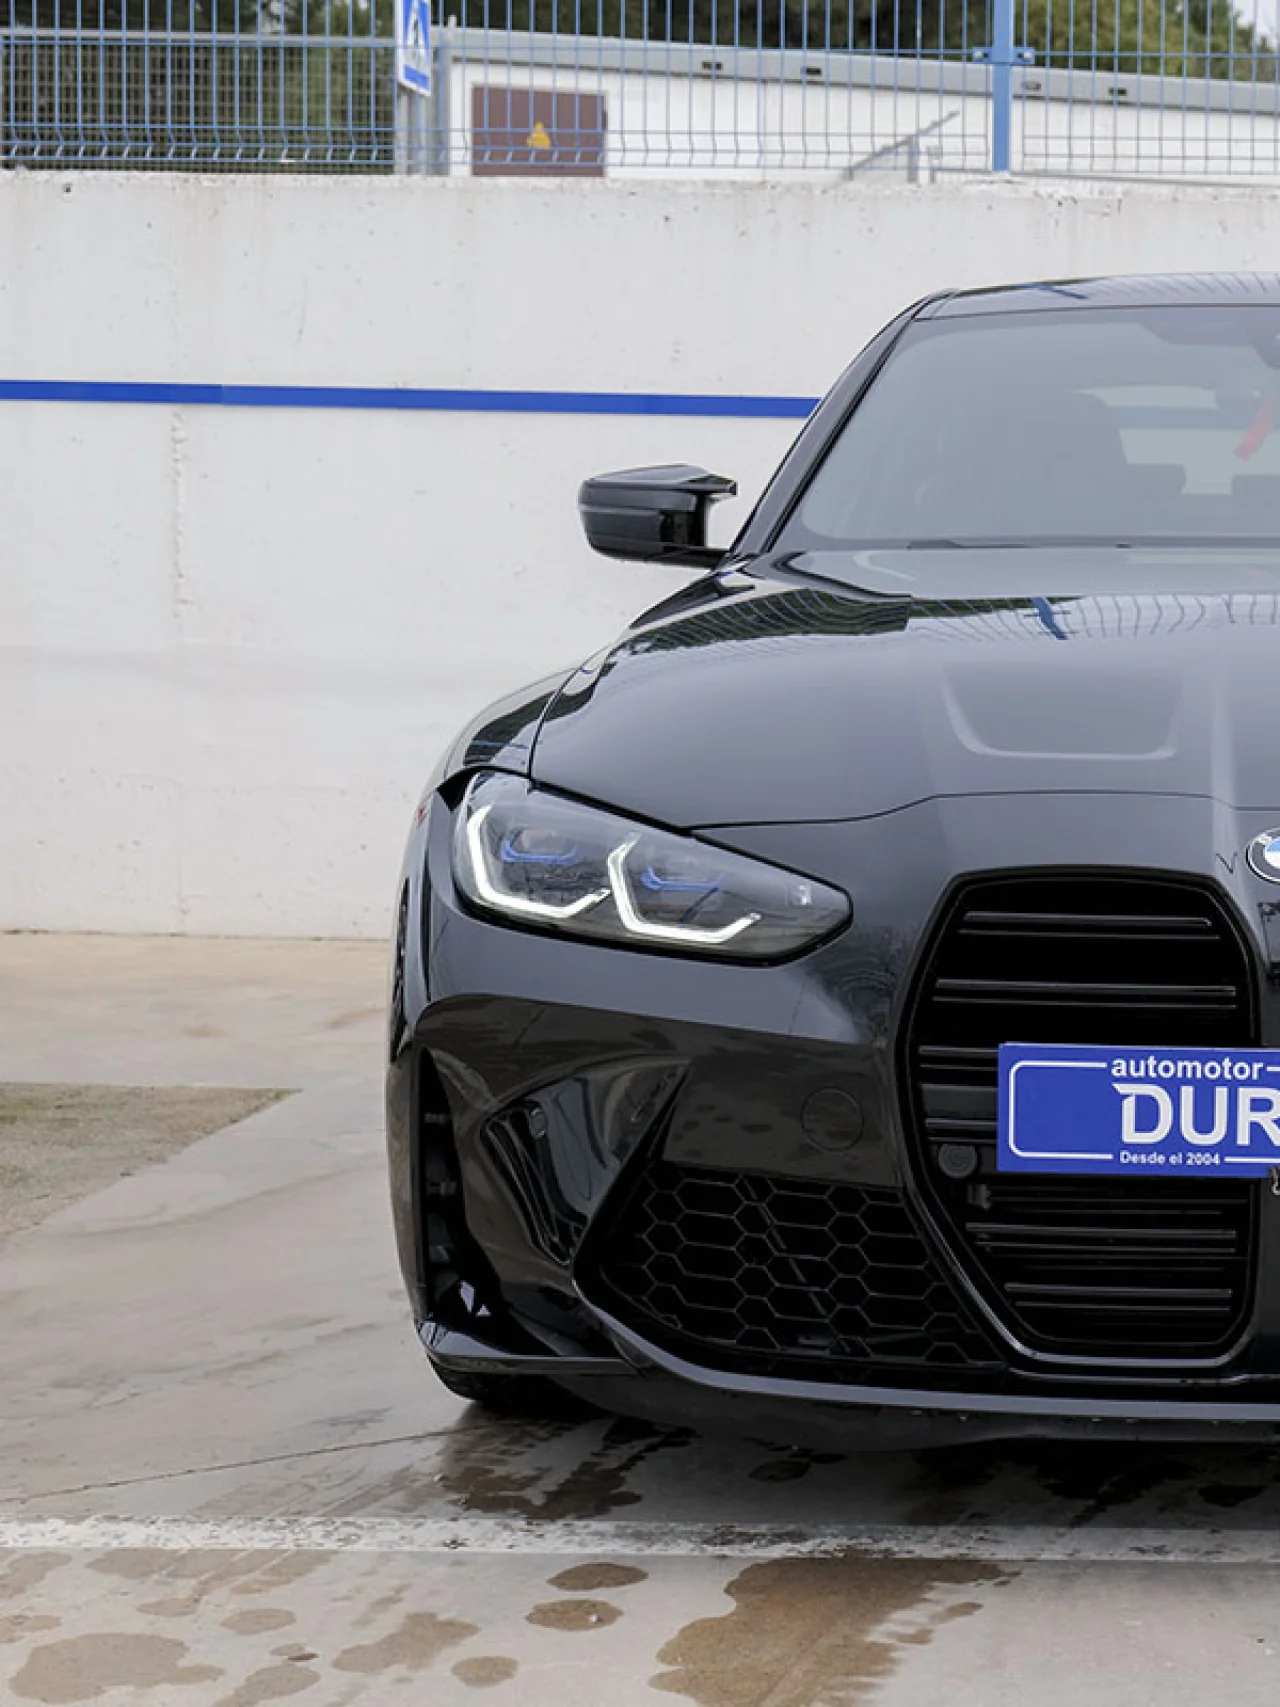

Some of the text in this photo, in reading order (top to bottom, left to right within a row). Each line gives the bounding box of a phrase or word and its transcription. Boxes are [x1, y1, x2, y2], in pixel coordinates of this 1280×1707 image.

[1111, 1056, 1264, 1081] automotor
[1119, 1150, 1221, 1166] Desde el 2004
